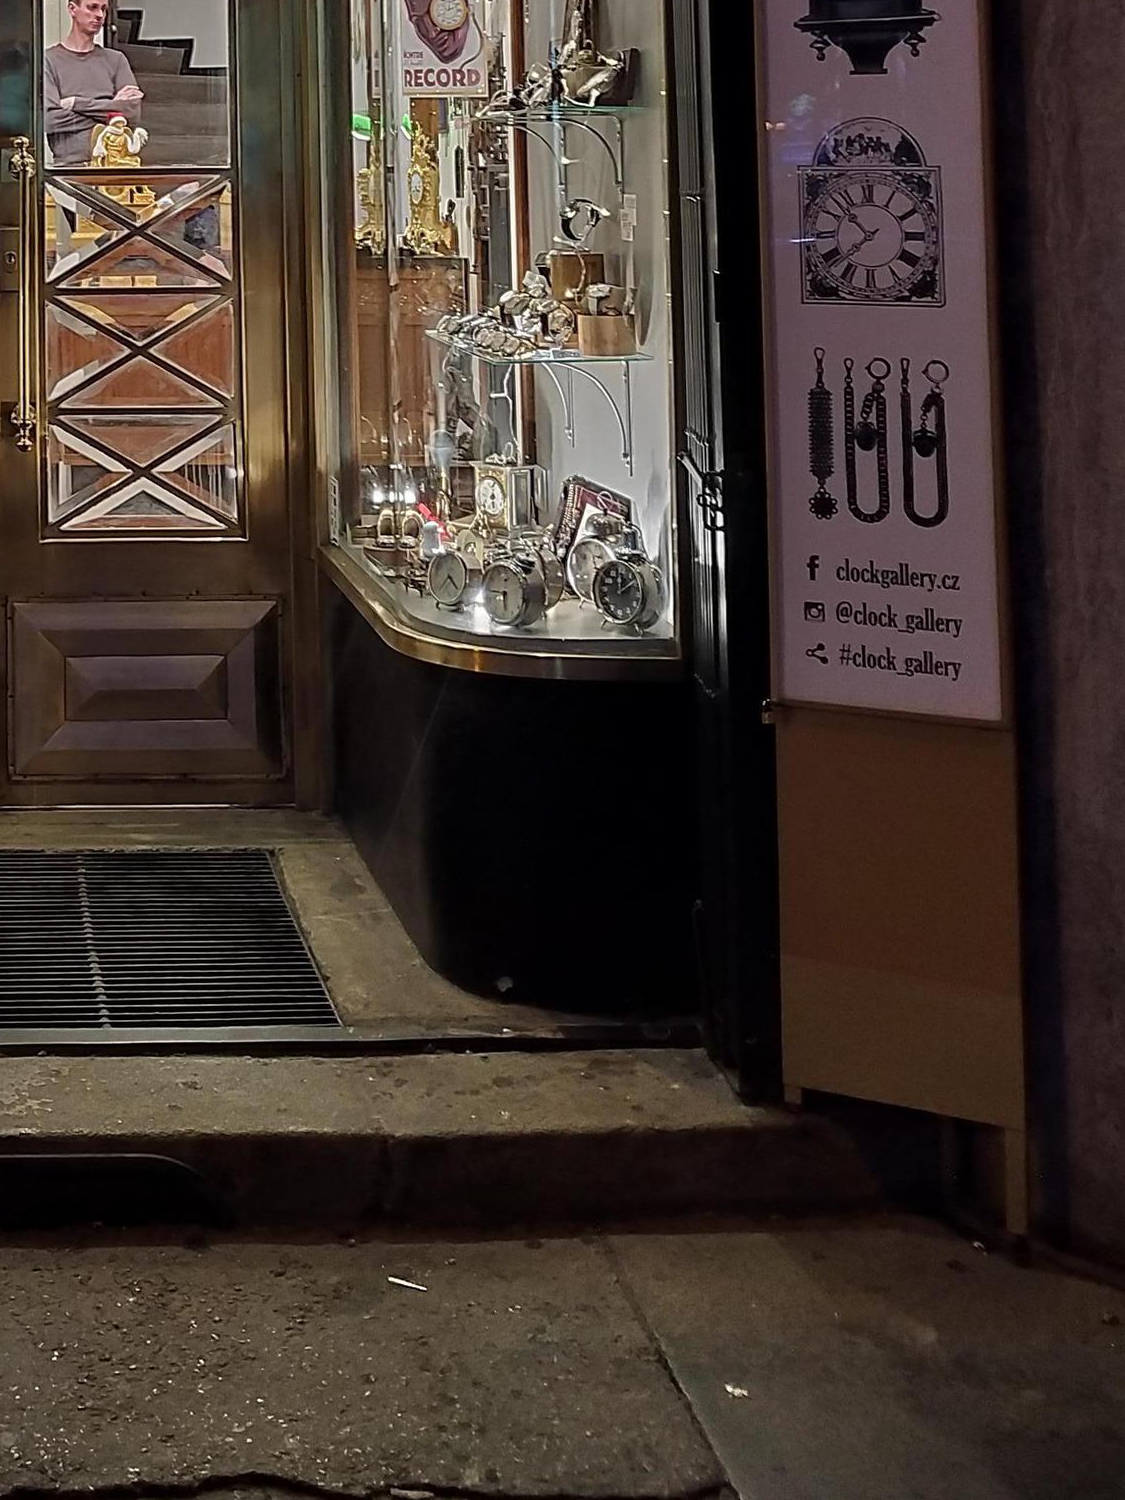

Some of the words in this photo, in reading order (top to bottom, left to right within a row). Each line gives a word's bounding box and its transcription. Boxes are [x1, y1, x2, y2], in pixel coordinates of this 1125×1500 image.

[404, 68, 481, 88] RECORD
[836, 558, 960, 592] clockgallery.cz
[836, 601, 963, 638] @clock_gallery
[839, 643, 963, 682] #clock_gallery
